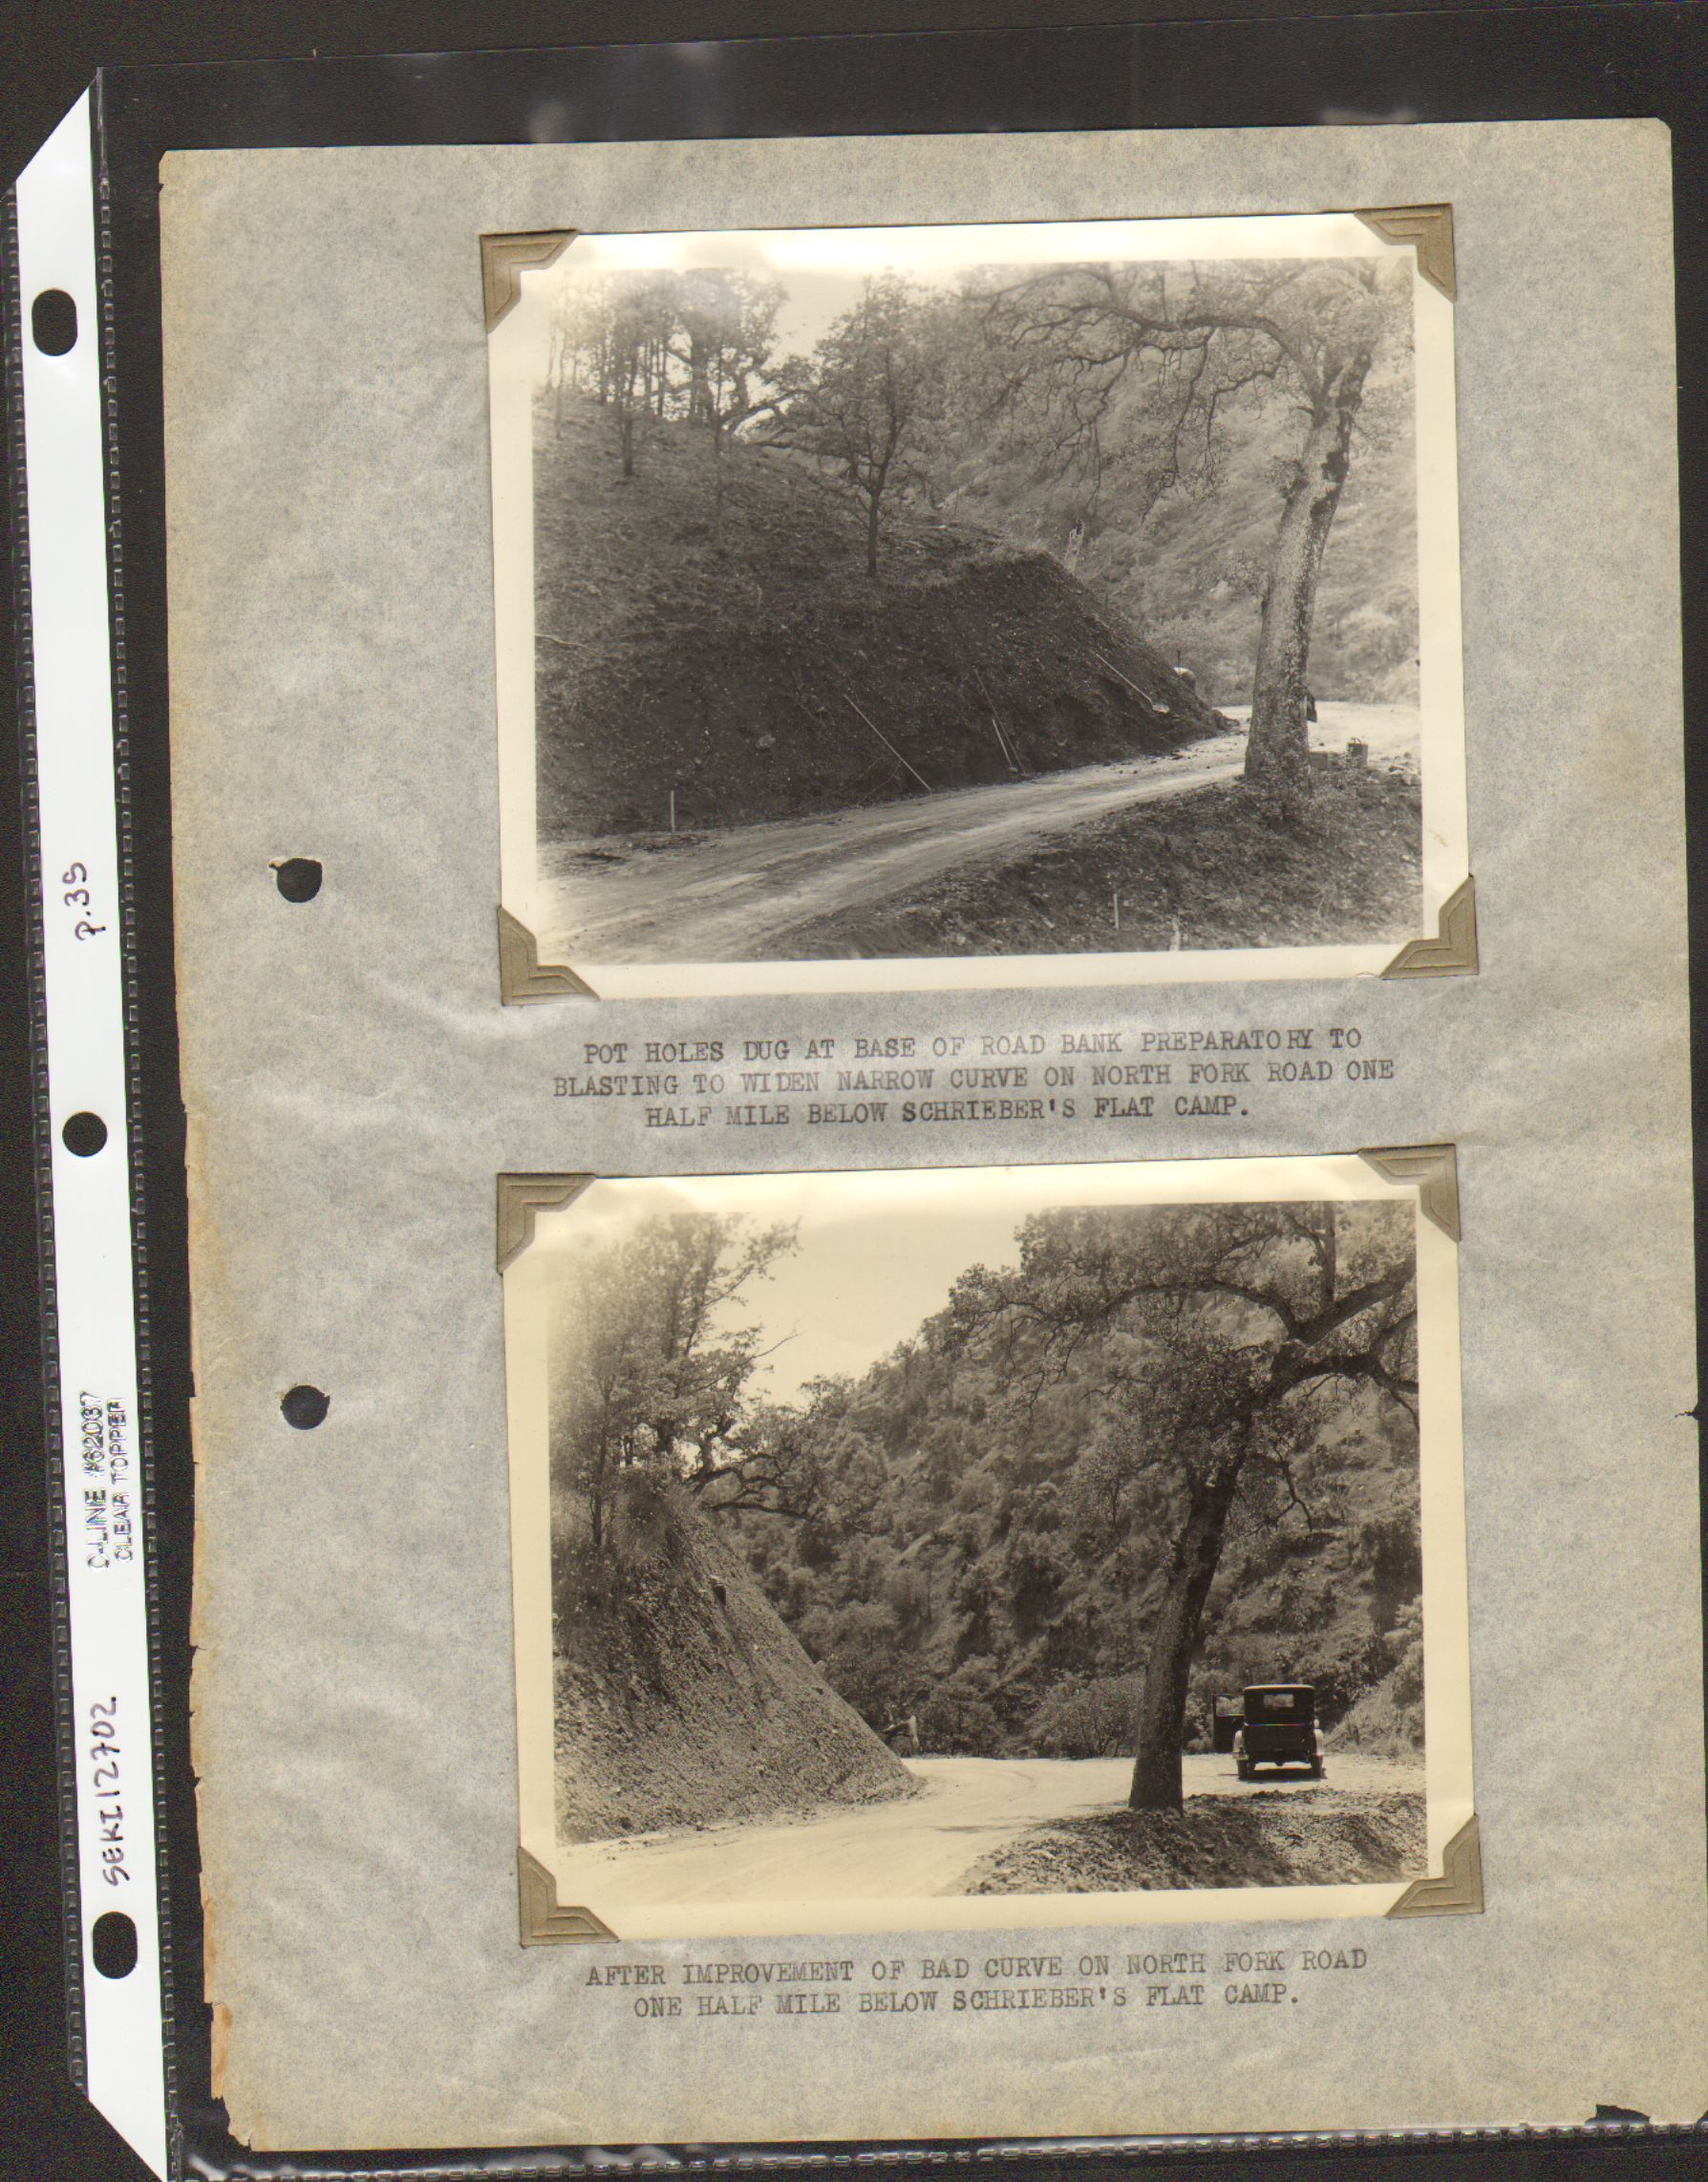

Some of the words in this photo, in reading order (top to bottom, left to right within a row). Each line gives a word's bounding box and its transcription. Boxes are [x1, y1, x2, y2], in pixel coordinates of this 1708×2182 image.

[584, 1043, 629, 1064] POT
[646, 1040, 725, 1062] HOLES
[743, 1039, 790, 1061] DUG
[804, 1038, 835, 1059] AT
[854, 1038, 916, 1059] BASE
[932, 1037, 965, 1057] OF
[981, 1034, 1045, 1056] ROAD
[1061, 1032, 1122, 1053] BANK
[1141, 1028, 1314, 1051] PREPARATORY
[1330, 1027, 1362, 1048] TO
[553, 1075, 679, 1097] BLASTING
[694, 1074, 725, 1094] TO
[743, 1072, 820, 1094] WIDEN
[837, 1069, 935, 1091] NARROW
[950, 1066, 1028, 1089] CURVE
[1044, 1065, 1074, 1087] ON
[1092, 1063, 1171, 1085] NORTH
[1188, 1062, 1250, 1083] FORK
[1268, 1060, 1334, 1082] ROAD
[1346, 1059, 1395, 1080] ONE
[646, 1106, 713, 1127] HALF
[726, 1104, 790, 1126] MILE
[807, 1102, 886, 1124] BELOW
[902, 1096, 1076, 1123] SCHRIEBER'S
[1094, 1097, 1154, 1118] FLAT
[1174, 1094, 1249, 1116] CAMP.
[78, 1391, 105, 1476] #62037
[106, 1397, 129, 1485] TOPPER
[83, 1487, 110, 1572] C-LINE
[111, 1492, 134, 1562] CLEAR
[585, 1964, 667, 1986] AFTER
[682, 1960, 854, 1984] IMPROVEMENT
[871, 1959, 906, 1980] OF
[921, 1958, 970, 1979] BAD
[985, 1957, 1062, 1978] CURVE
[1078, 1956, 1109, 1975] ON
[1127, 1953, 1206, 1975] NORTH
[1224, 1952, 1286, 1973] FORK
[1301, 1949, 1367, 1970] ROAD
[634, 1996, 681, 2018] ONE
[697, 1995, 762, 2016] HALF
[775, 1993, 841, 2014] MILE
[859, 1991, 938, 2013] BELOW
[952, 1988, 1127, 2011] SCHRIEBER'S
[1146, 1985, 1204, 2006] FLAT
[1225, 1984, 1299, 2004] CAMP.
